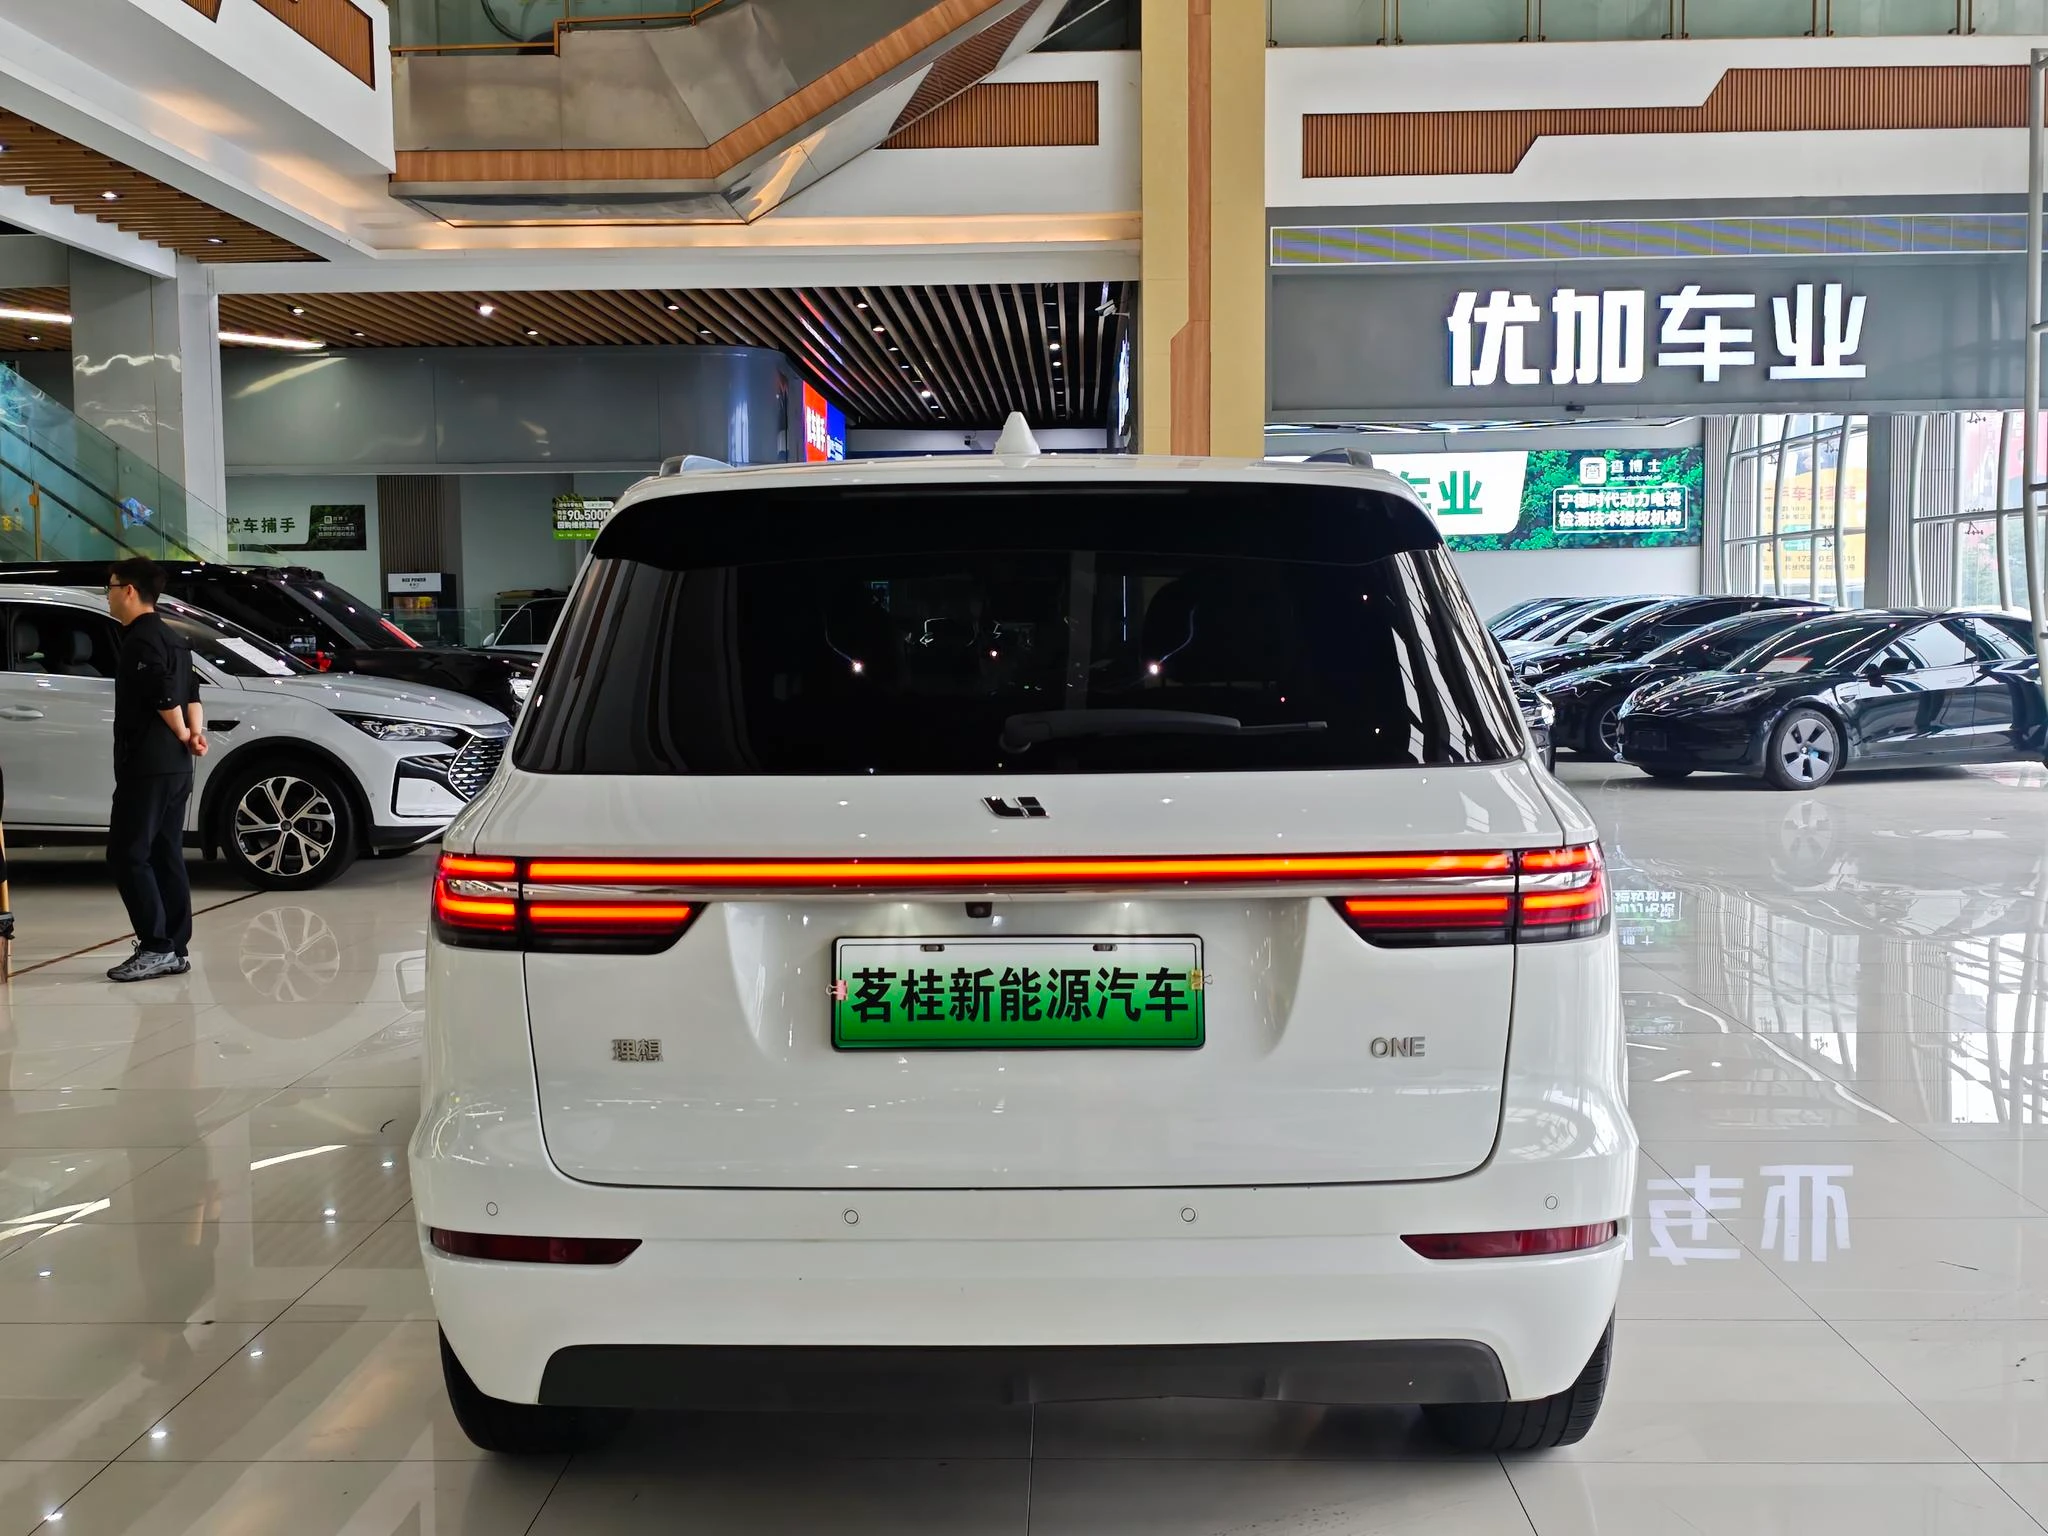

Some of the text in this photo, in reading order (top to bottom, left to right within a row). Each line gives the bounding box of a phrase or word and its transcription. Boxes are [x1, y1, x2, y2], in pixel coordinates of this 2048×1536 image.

[1447, 283, 1867, 386] 优加车业
[1610, 459, 1661, 474] 查博士
[1558, 491, 1682, 509] 宁德时代动力电池
[1558, 510, 1682, 527] 检测技术授权机构
[851, 967, 1189, 1023] 茗桂新能源汽车
[612, 1038, 663, 1062] 理想
[1371, 1036, 1426, 1059] ONE
